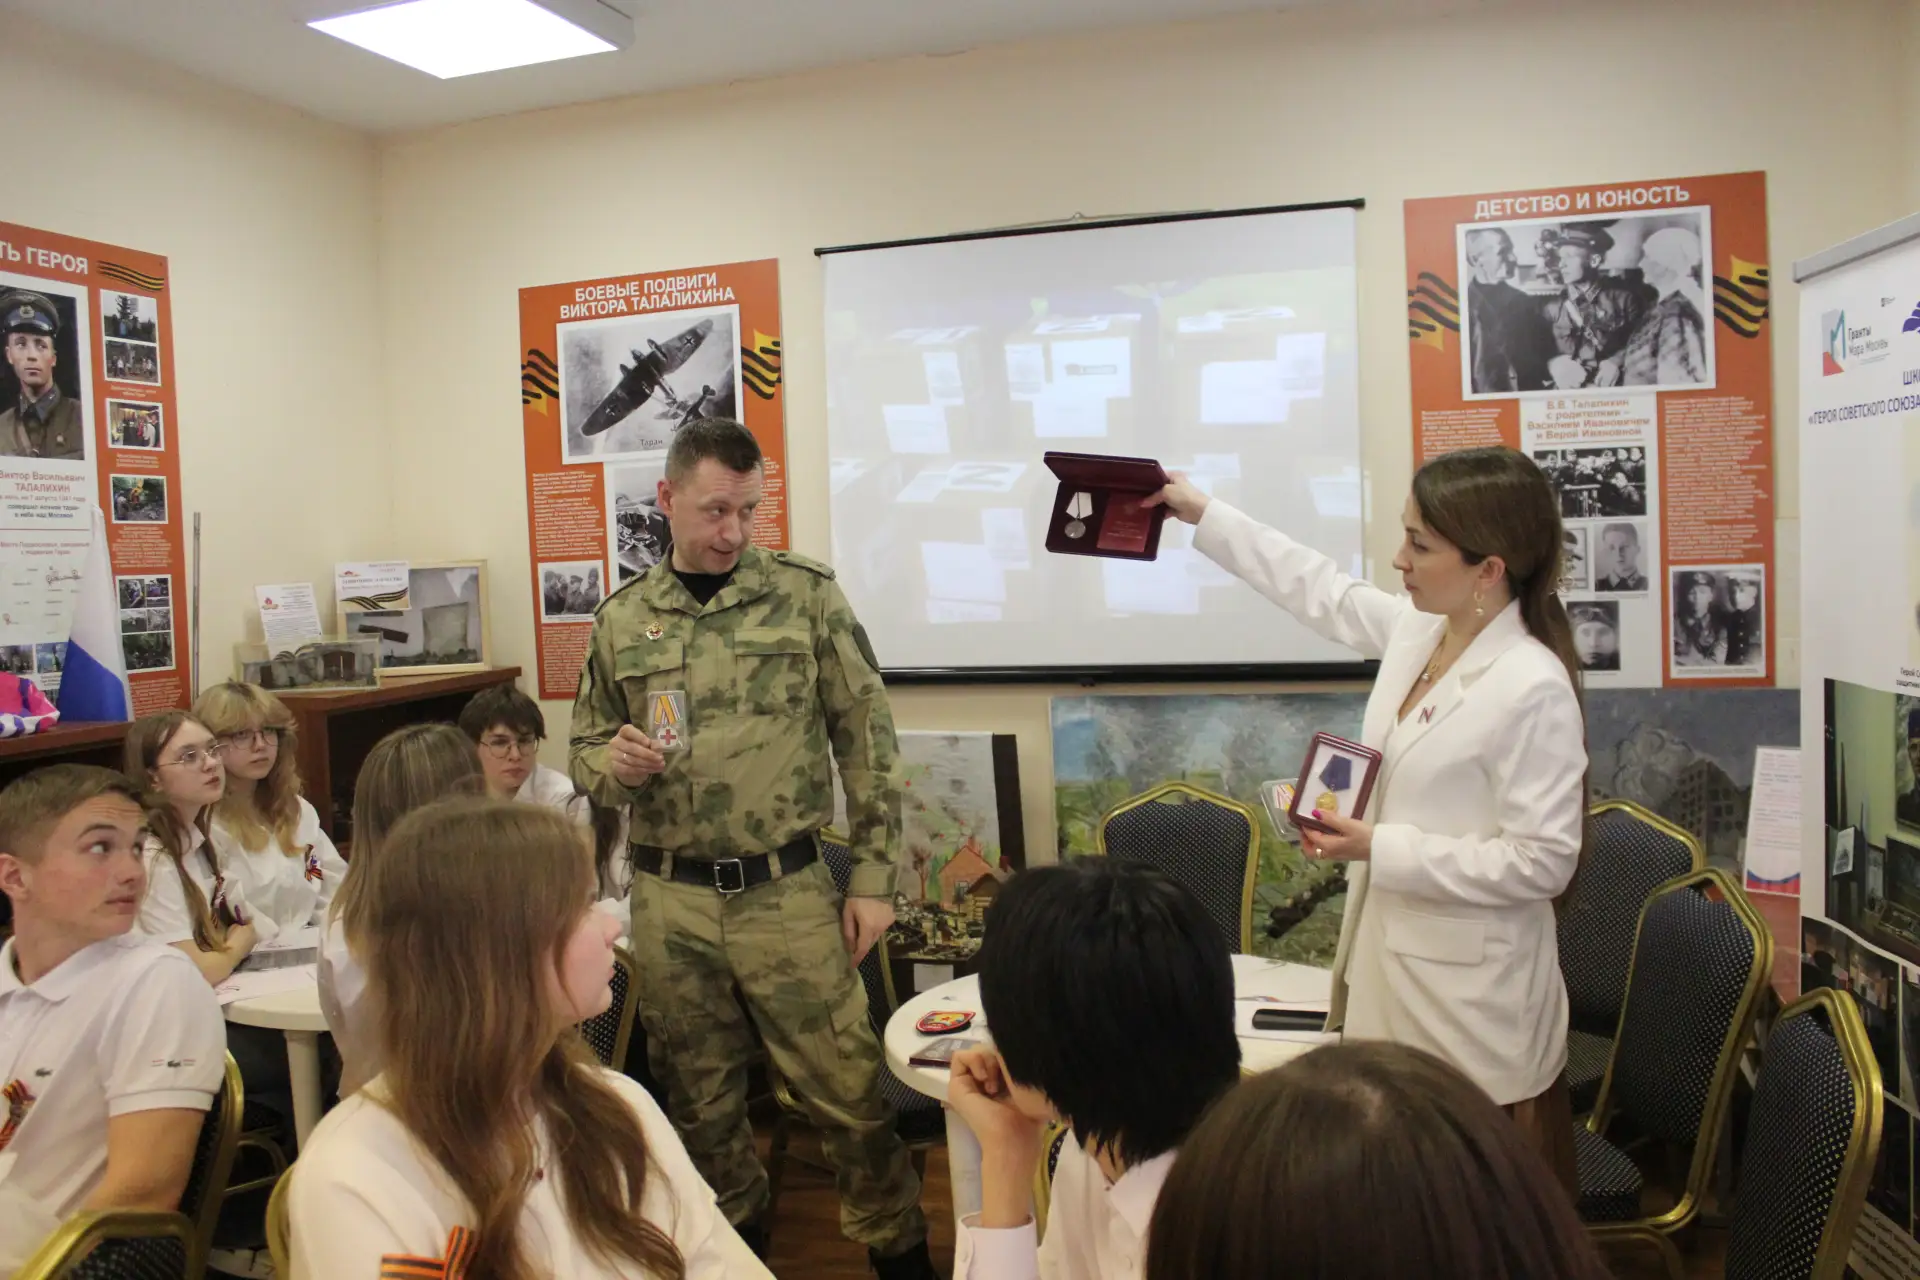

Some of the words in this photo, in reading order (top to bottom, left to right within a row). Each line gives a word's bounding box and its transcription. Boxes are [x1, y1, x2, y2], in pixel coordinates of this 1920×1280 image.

[1474, 194, 1570, 220] ДЕТСТВО
[1576, 193, 1590, 209] И
[1596, 185, 1690, 207] ЮНОСТЬ
[27, 246, 89, 275] ГЕРОЯ
[575, 281, 640, 302] БОЕВЫЕ
[643, 272, 717, 294] ПОДВИГИ
[560, 299, 628, 319] ВИКТОРА
[631, 287, 735, 311] ТАЛАЛИХИНА
[1848, 326, 1872, 341] Гранты
[1903, 369, 1920, 385] ШК
[1572, 399, 1629, 409] Талалихин
[1555, 410, 1621, 420] родителями
[1808, 408, 1837, 425] «ГЕРОЯ
[1839, 400, 1886, 421] СОВЕТСКОГО
[1584, 418, 1649, 428] Ивановичем
[0, 470, 30, 481] Виктор
[33, 471, 86, 481] Васильевич
[15, 483, 71, 492] ТАЛАЛИХИН
